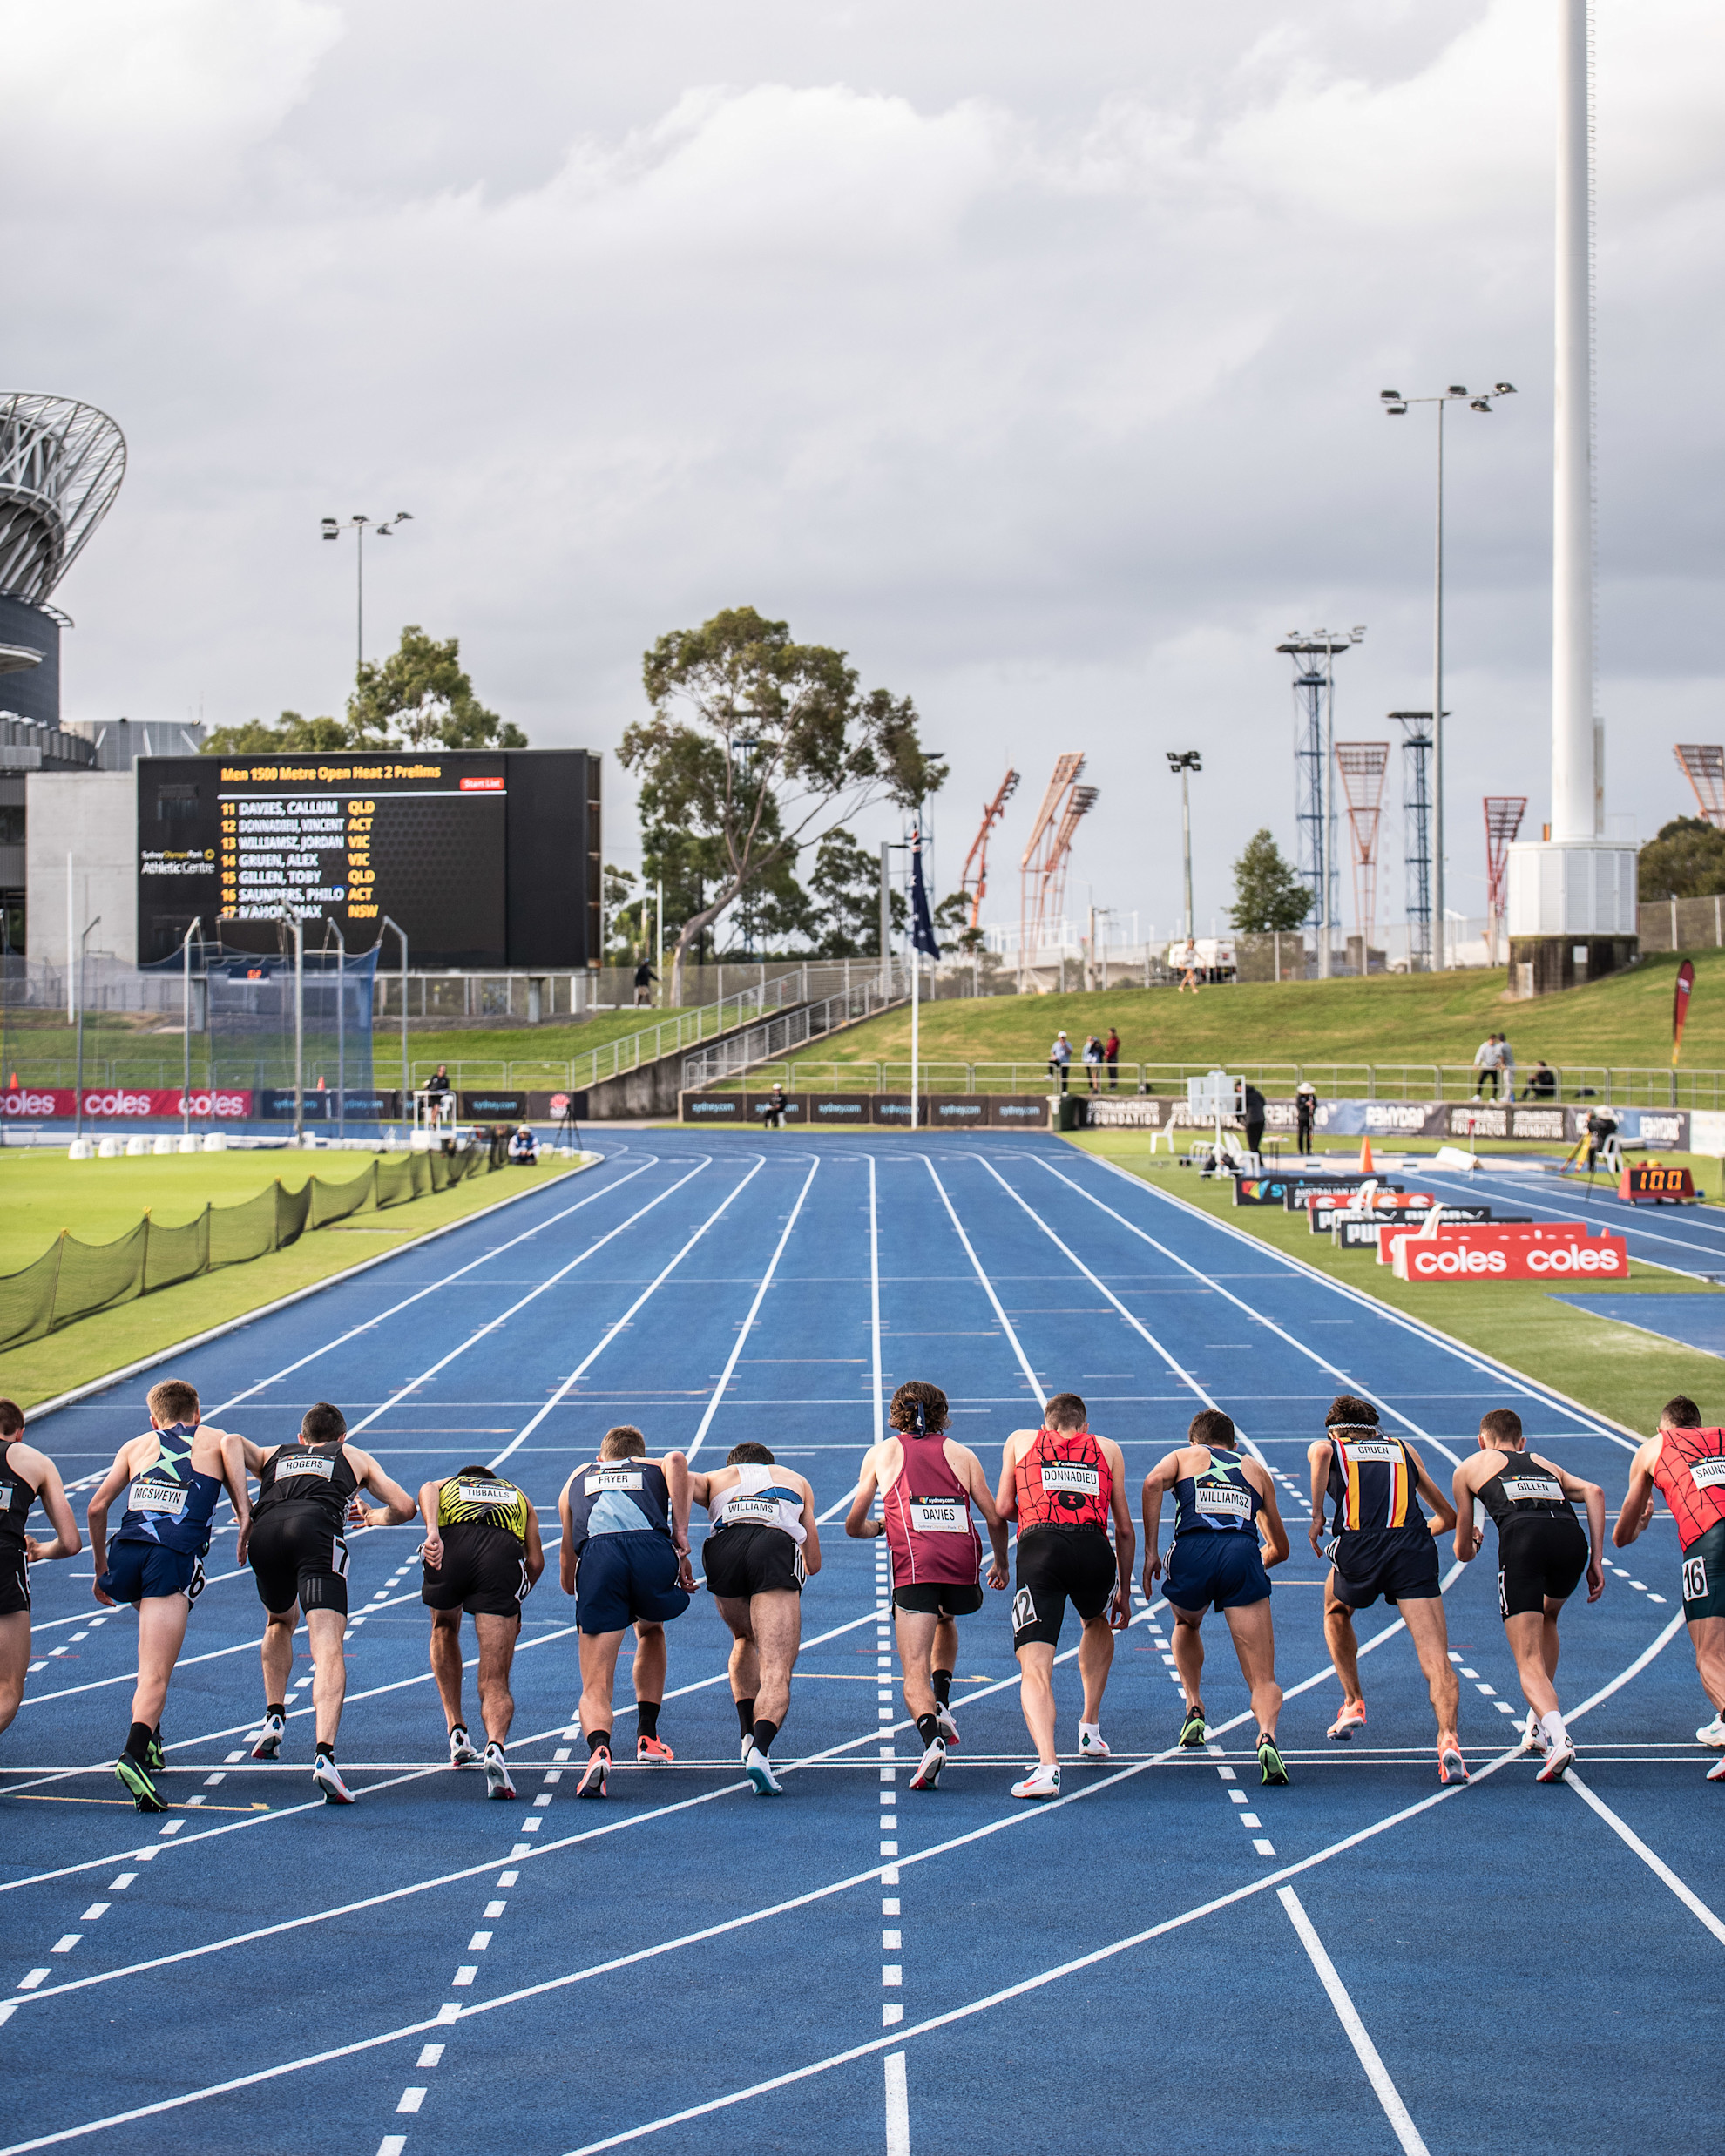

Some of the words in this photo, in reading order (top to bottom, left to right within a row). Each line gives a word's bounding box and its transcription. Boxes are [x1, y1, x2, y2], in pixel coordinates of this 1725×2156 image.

[221, 768, 248, 781] Men
[250, 767, 278, 781] 1500
[279, 767, 316, 781] Metre
[317, 767, 351, 783] Open
[353, 766, 383, 779] Heat
[384, 766, 392, 779] 2
[394, 765, 441, 778] Prelims
[464, 779, 484, 788] Start
[220, 802, 235, 815] 11
[238, 801, 287, 816] DAVIES,
[287, 801, 338, 815] CALLUM
[348, 801, 375, 816] QLD
[220, 820, 236, 833] 12
[238, 819, 301, 834] DONNADIEU,
[301, 818, 345, 832] VINCENT
[348, 818, 373, 831] ACT
[220, 836, 236, 850] 13
[300, 835, 344, 852] JORDAN
[348, 835, 370, 849] VIC
[220, 855, 236, 868] 14
[238, 854, 285, 868] GRUEN,
[286, 853, 319, 867] ALEX
[348, 852, 370, 866] VIC
[141, 861, 181, 875] Athletic
[181, 861, 215, 875] Centre
[220, 871, 236, 884] 15
[238, 870, 287, 885] GILLEN,
[288, 870, 321, 884] TOBY
[348, 869, 375, 885] QLD
[220, 889, 236, 902] 16
[238, 888, 305, 902] SAUNDERS,
[306, 888, 344, 902] PHILO
[348, 887, 373, 901] ACT
[220, 905, 236, 919] 17
[348, 904, 378, 918] NSW
[85, 1090, 151, 1115] coles
[472, 1099, 518, 1112] sydney.com
[692, 1102, 735, 1113] sydney.com
[818, 1103, 861, 1114] sydney.com
[939, 1104, 981, 1115] sydney.com
[999, 1105, 1040, 1116] sydney.com
[1086, 1112, 1160, 1125] FOUNDATION
[1640, 1171, 1682, 1190] 100
[1415, 1245, 1507, 1274] coles
[1526, 1243, 1620, 1272] coles
[1357, 1446, 1390, 1455] GRUEN
[286, 1460, 323, 1470] ROGERS
[599, 1475, 628, 1484] FRYER
[1044, 1470, 1098, 1484] DONNADIEU
[1216, 1482, 1243, 1490] sydney.com
[1517, 1482, 1550, 1491] GILLEN
[133, 1487, 182, 1504] MCSWEYN
[467, 1489, 510, 1498] TIBBALLS
[1199, 1490, 1249, 1509] WILLIAMSZ
[728, 1503, 774, 1514] WILLIAMS
[923, 1508, 956, 1521] DAVIES
[188, 1563, 206, 1599] 6
[1683, 1560, 1705, 1598] 16
[1012, 1591, 1035, 1627] 12
